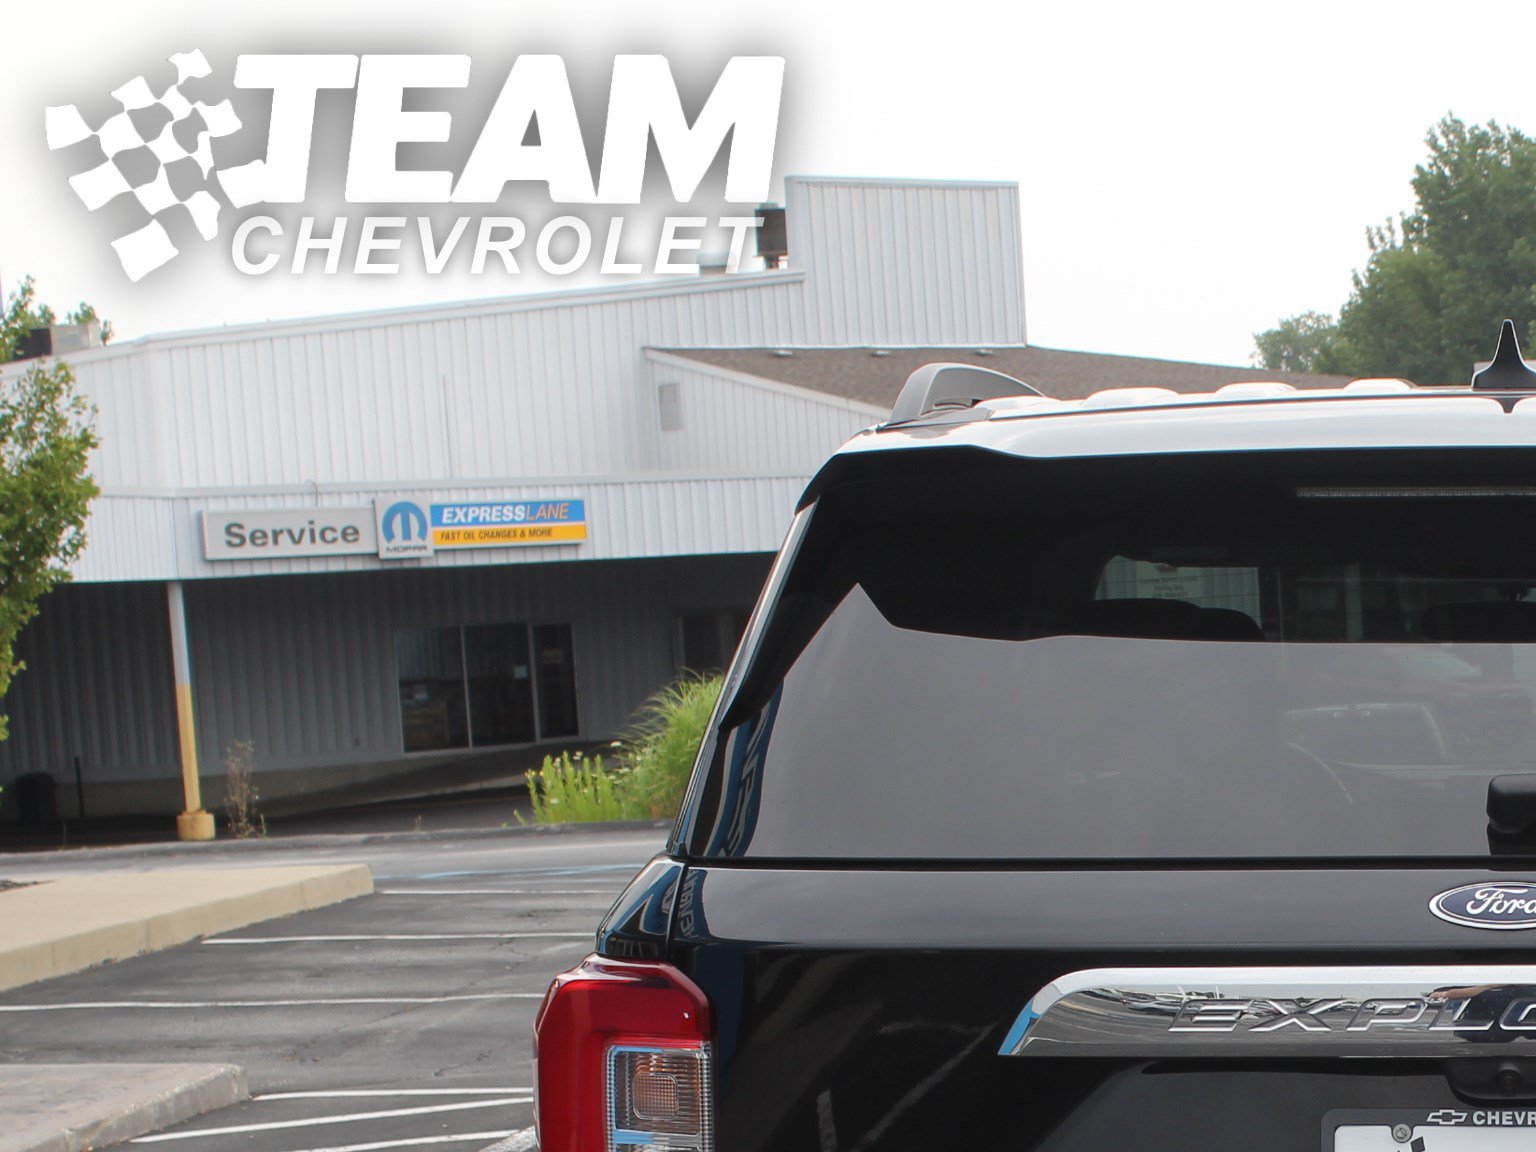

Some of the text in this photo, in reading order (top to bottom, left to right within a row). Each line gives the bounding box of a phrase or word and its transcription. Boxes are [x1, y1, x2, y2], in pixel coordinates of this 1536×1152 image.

[224, 520, 361, 549] Service
[440, 528, 553, 541] FAST OIL CHANGES & MORE
